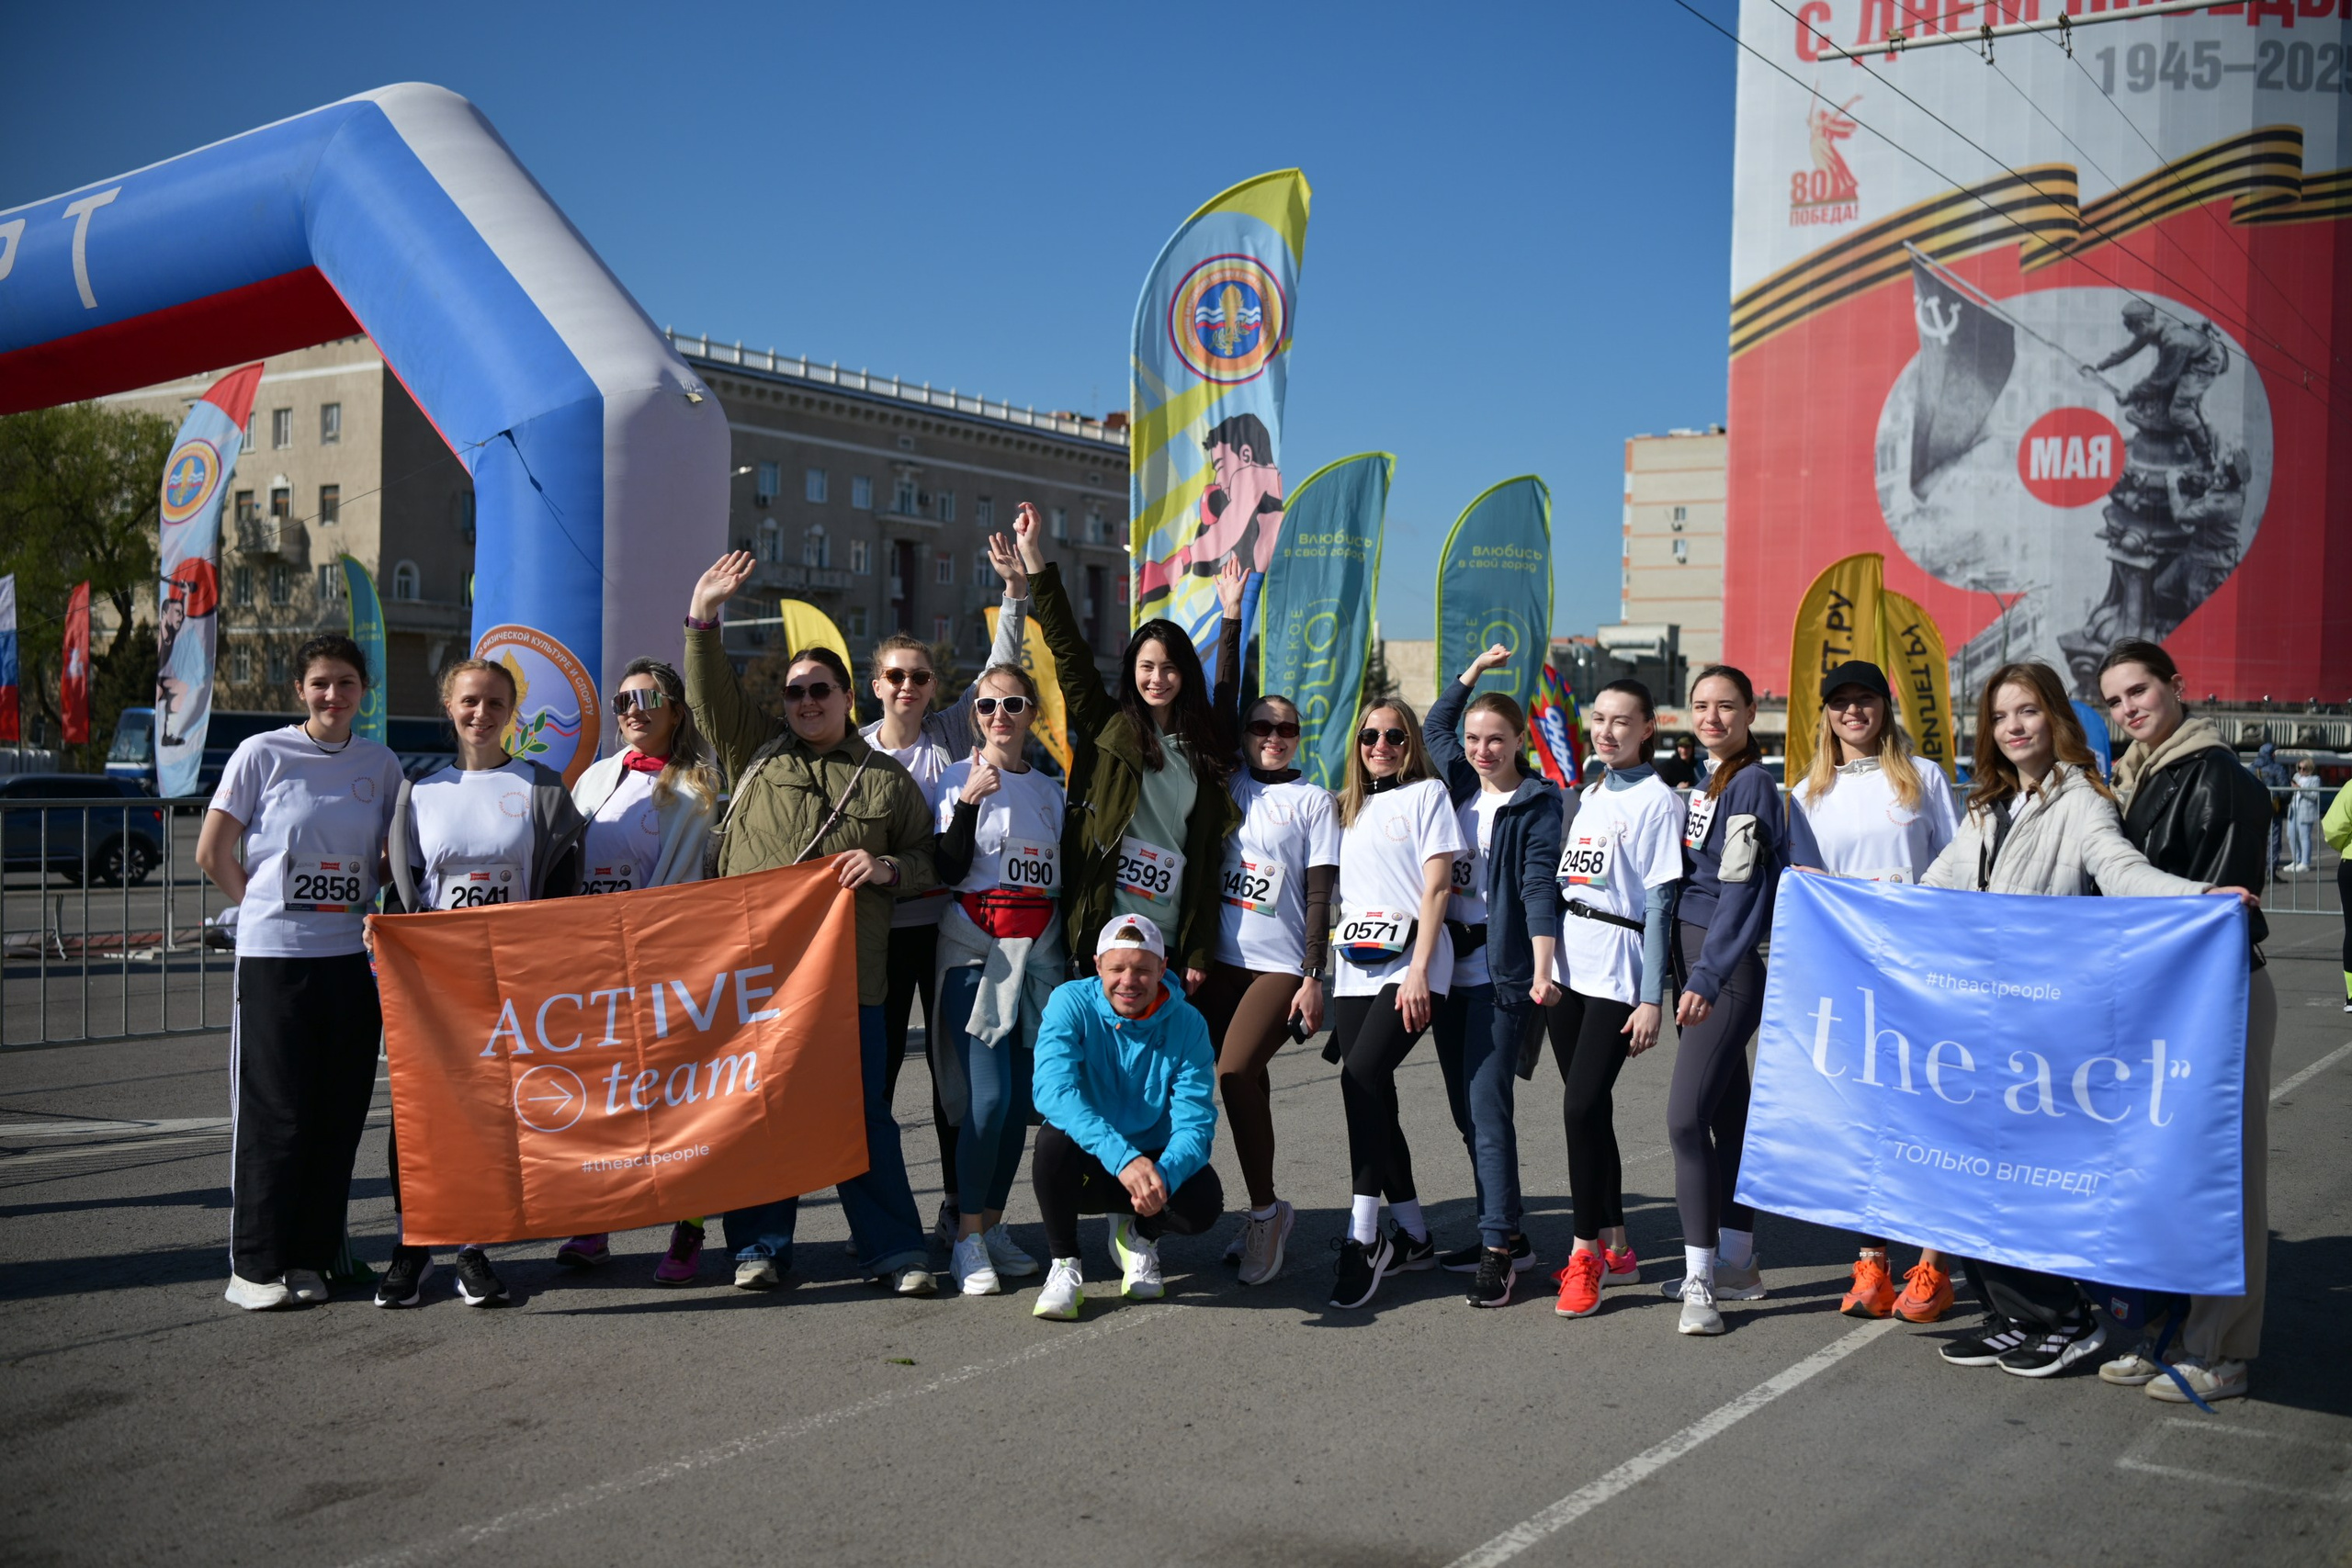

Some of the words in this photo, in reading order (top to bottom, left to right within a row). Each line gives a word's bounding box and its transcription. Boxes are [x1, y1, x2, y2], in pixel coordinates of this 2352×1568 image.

[1795, 1, 1832, 62] С
[2096, 39, 2352, 95] 1945–202
[1791, 169, 1827, 204] 80
[1790, 204, 1860, 227] ПОБЕДА!
[2029, 434, 2112, 481] МАЯ
[1299, 528, 1373, 548] влюбись
[1472, 544, 1543, 561] влюбись
[1295, 546, 1327, 558] свой
[1330, 547, 1366, 562] город
[1458, 559, 1466, 569] в
[1469, 558, 1498, 569] свой
[1501, 560, 1537, 573] город
[481, 630, 530, 649] ФИЗИЧЕСКОЙ
[530, 637, 572, 671] КУЛЬТУРЕ
[569, 668, 579, 678] И
[574, 677, 594, 716] СПОРТУ
[1008, 858, 1053, 886] 0190
[1116, 855, 1171, 893] 2593
[1561, 850, 1606, 874] 2458
[293, 874, 360, 902] 2858
[451, 886, 509, 909] 2641
[1224, 870, 1271, 902] 1462
[1343, 921, 1399, 942] 0571
[1925, 971, 2062, 1002] #theactpeople
[479, 964, 780, 1057] ACTIVE
[1807, 987, 1975, 1104] the
[602, 1051, 761, 1116] team
[582, 1144, 710, 1173] #theactpeople
[1894, 1141, 1991, 1178] ТОЛЬКО
[1996, 1161, 2099, 1197] ВПЕРЕД!
